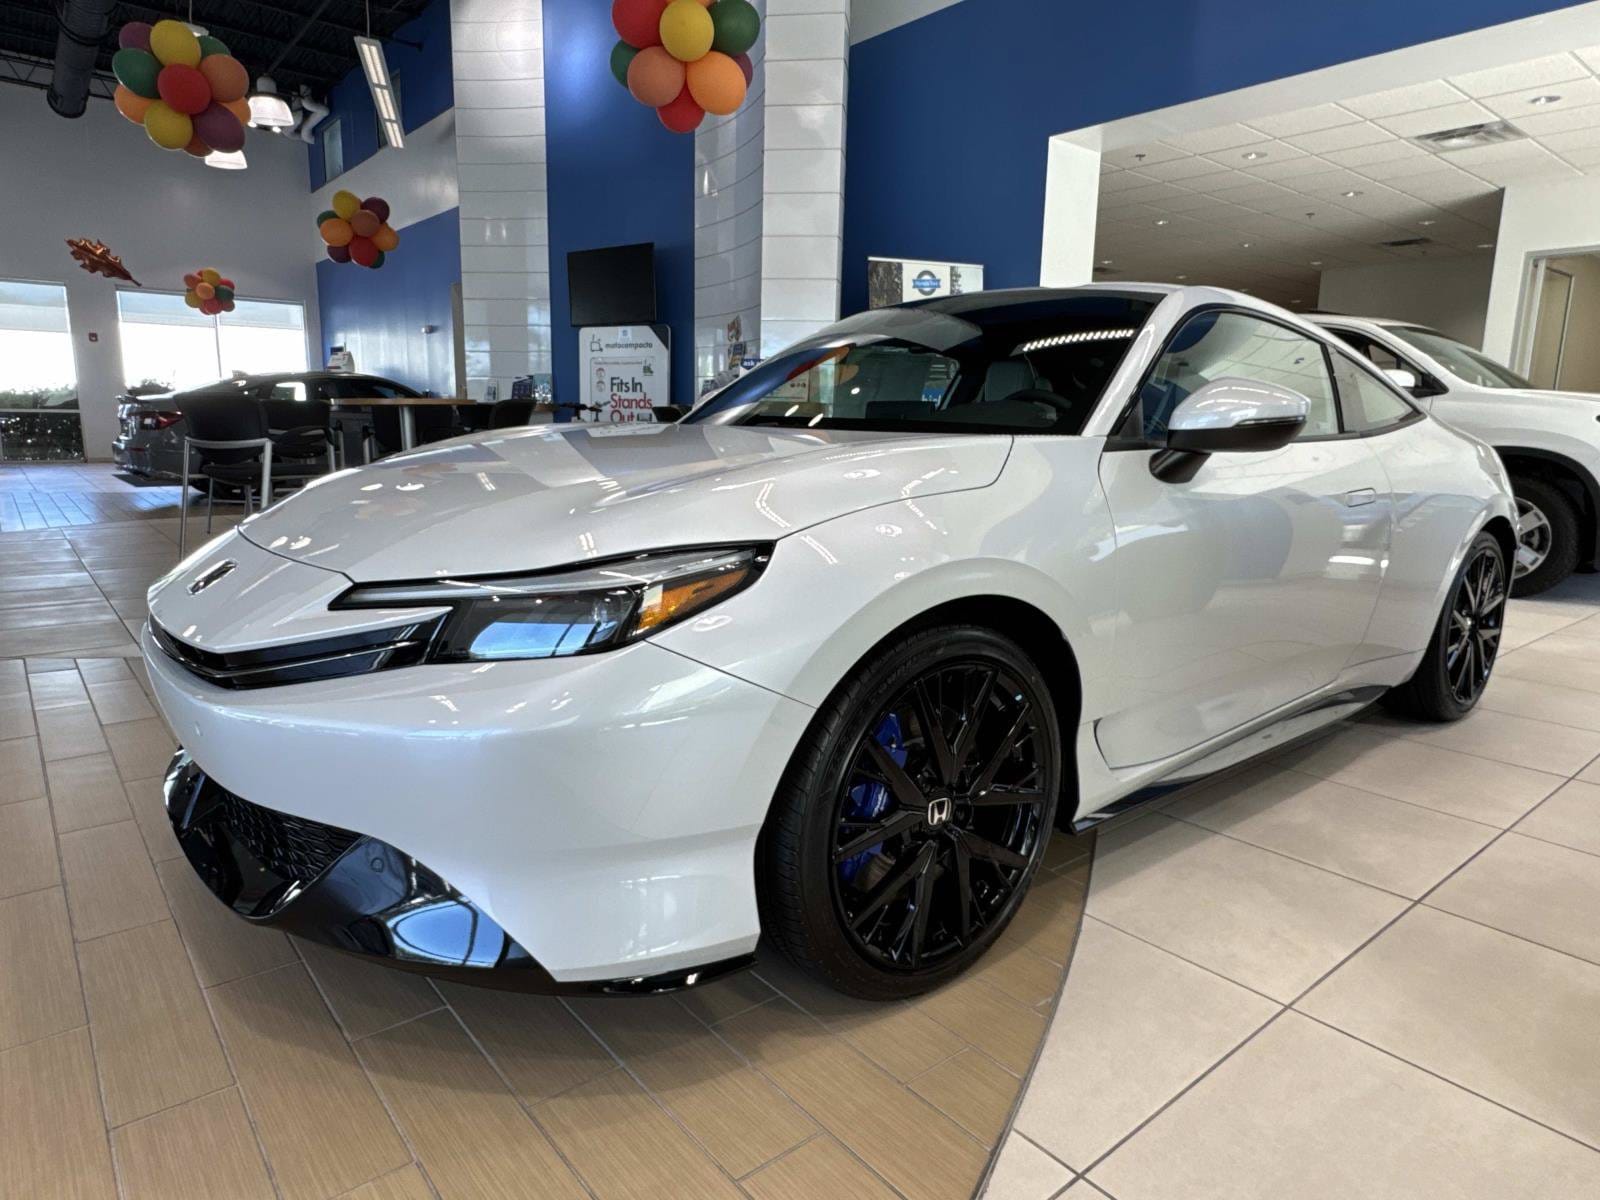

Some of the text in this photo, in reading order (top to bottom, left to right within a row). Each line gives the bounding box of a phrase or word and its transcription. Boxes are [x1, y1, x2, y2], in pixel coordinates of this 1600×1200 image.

[610, 377, 642, 393] Fits In
[610, 392, 652, 409] Stands
[610, 409, 635, 424] Out
